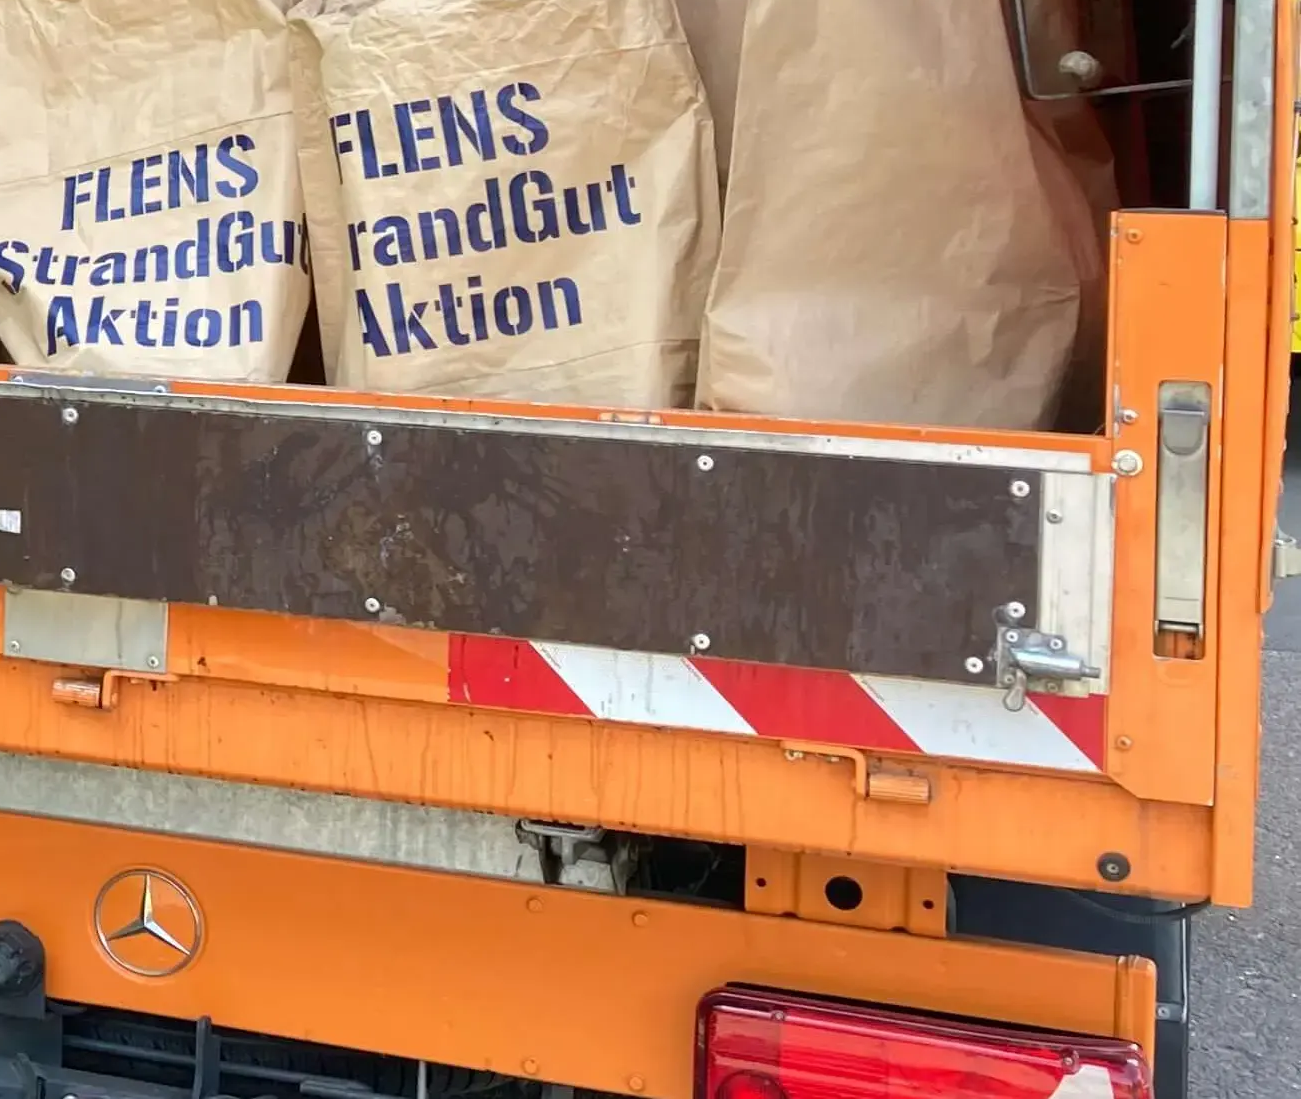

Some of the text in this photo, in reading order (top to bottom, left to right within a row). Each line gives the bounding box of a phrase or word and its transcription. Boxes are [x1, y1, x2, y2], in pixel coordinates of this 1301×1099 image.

[329, 82, 549, 185] FLENS
[61, 134, 259, 231] FLENS
[347, 164, 642, 271] randGut
[46, 296, 263, 357] Aktion
[354, 275, 583, 358] Aktion
